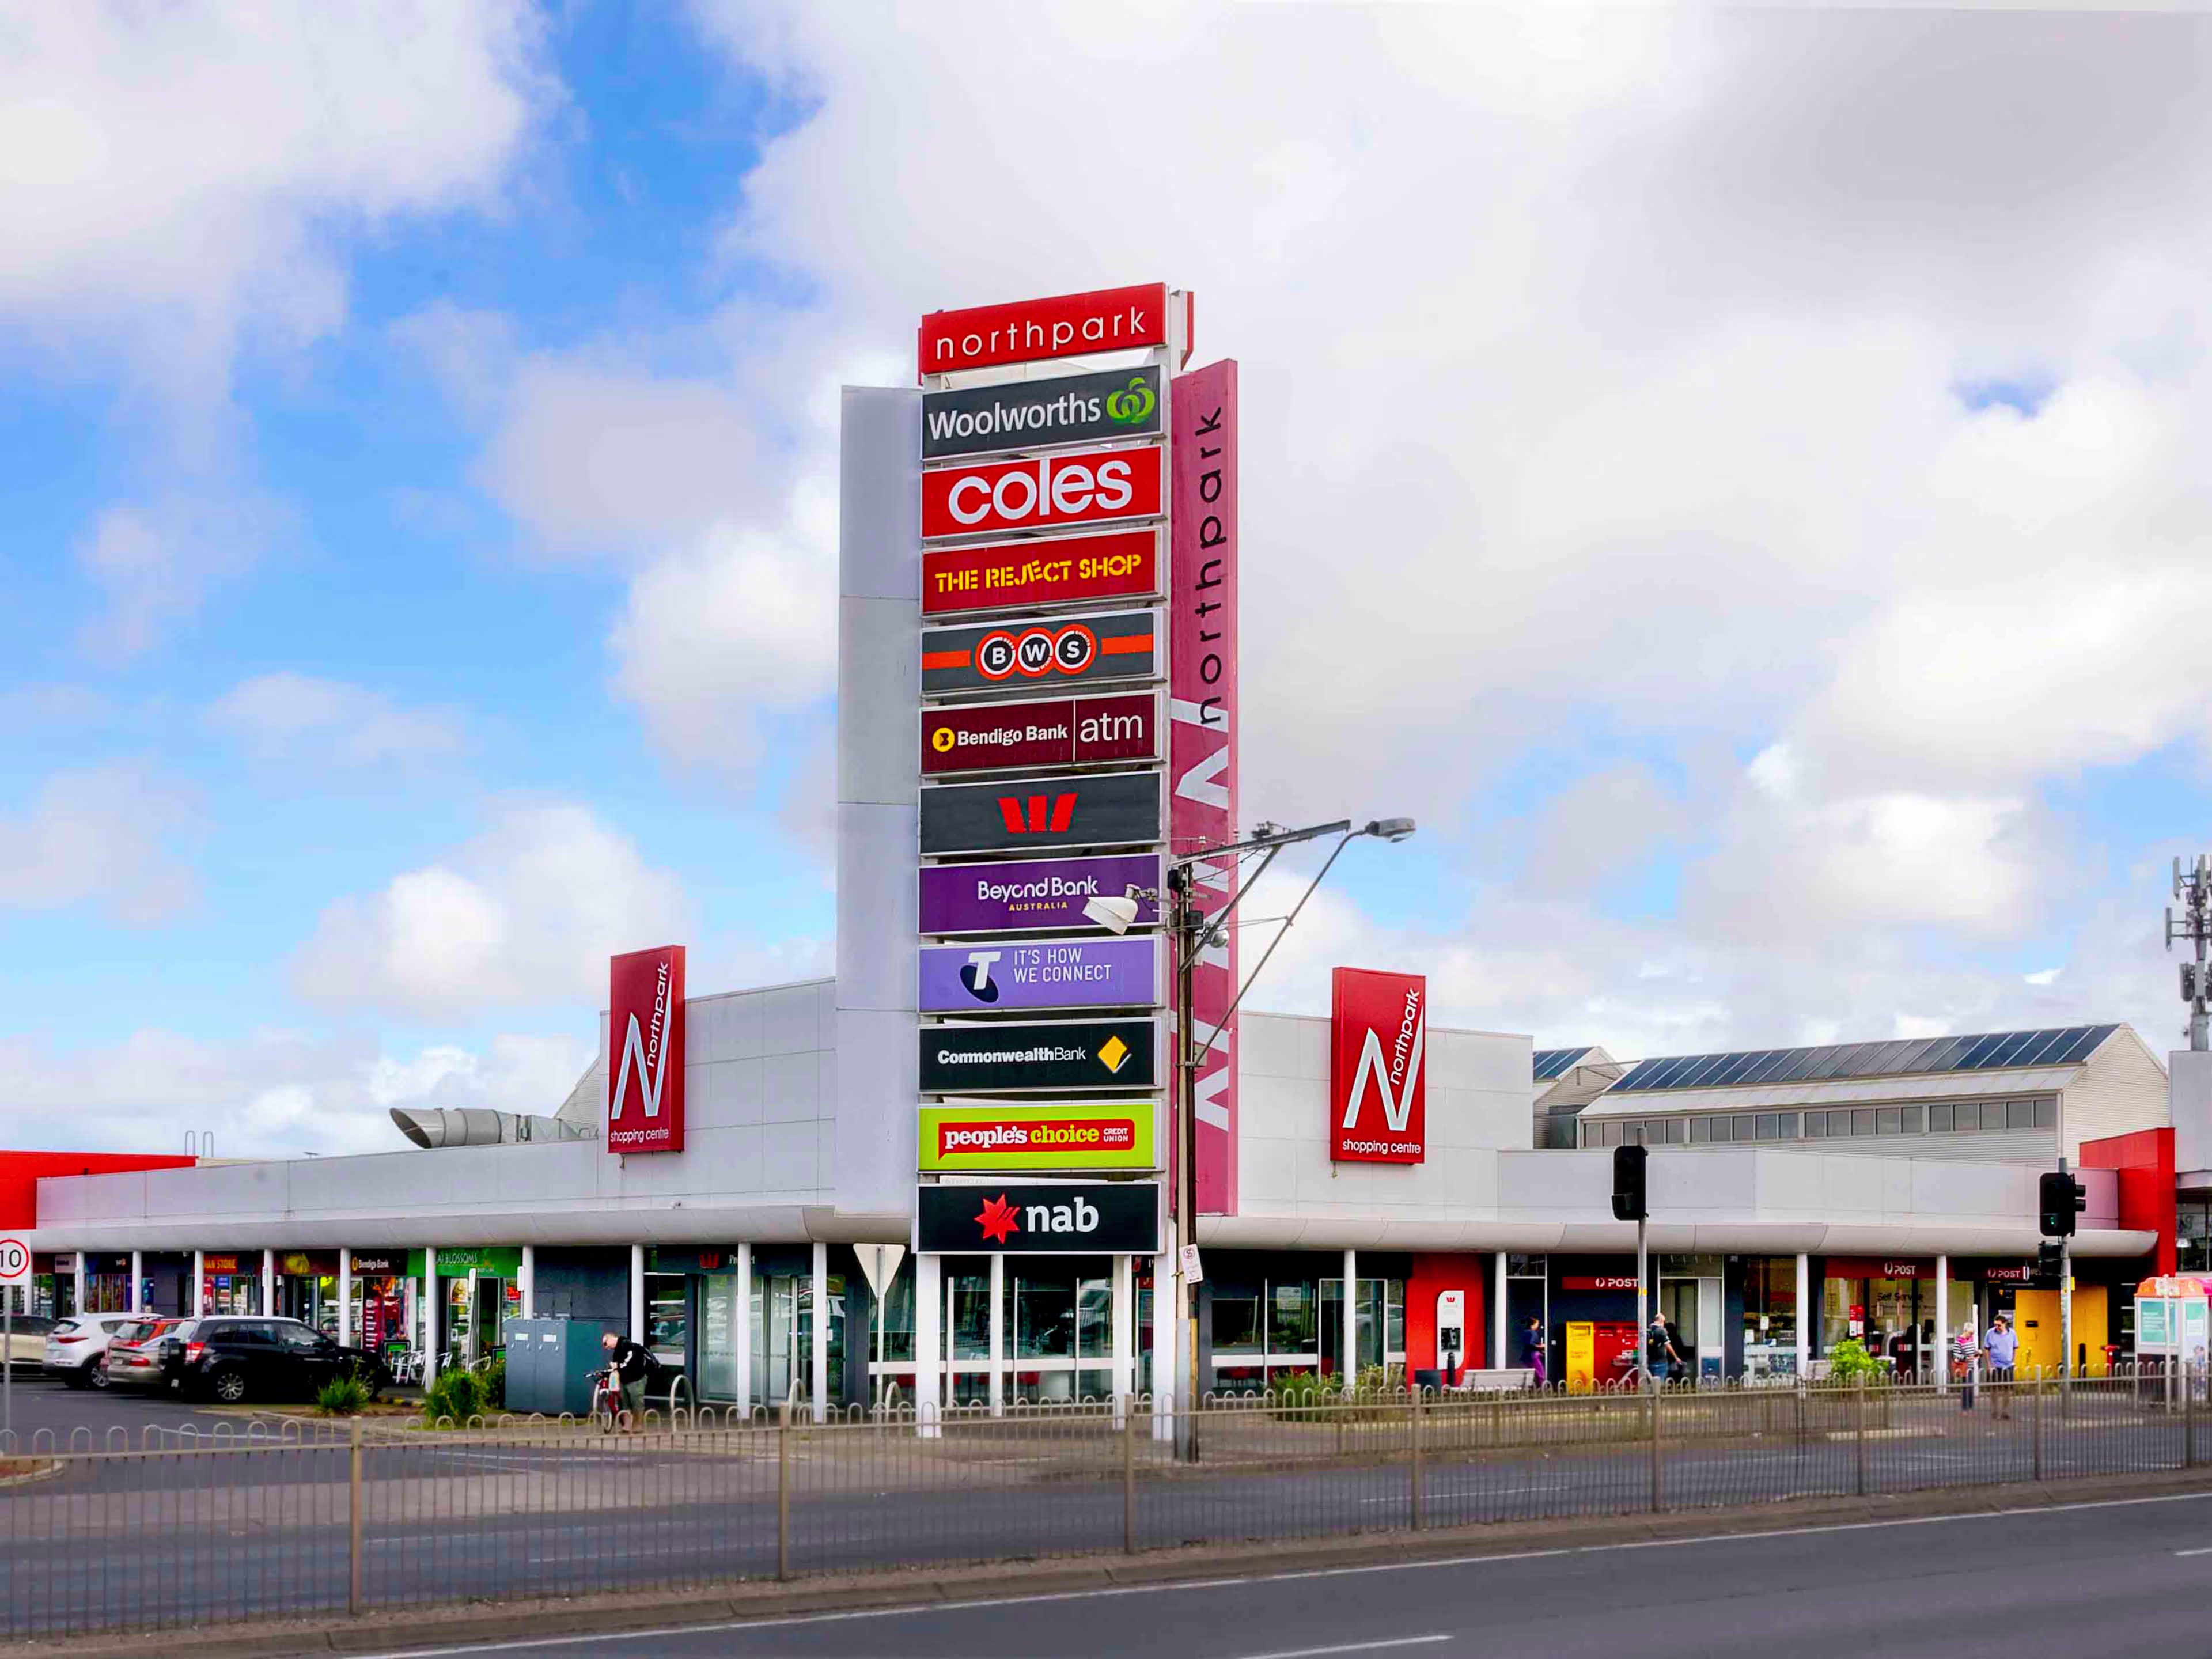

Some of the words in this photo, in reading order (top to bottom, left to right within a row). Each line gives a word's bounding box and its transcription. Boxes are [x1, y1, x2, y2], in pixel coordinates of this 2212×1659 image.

[937, 306, 1145, 360] northpark
[928, 393, 1101, 440] Woolworths
[949, 458, 1132, 525] coles
[935, 570, 978, 593] THE
[986, 560, 1072, 589] REJECT
[1079, 554, 1142, 579] SHOP
[1195, 407, 1226, 725] northpark
[957, 728, 1023, 747] Bendigo
[1026, 724, 1069, 741] Bank
[1080, 713, 1143, 743] atm
[978, 877, 1048, 903] Beyond
[1051, 875, 1099, 896] Bank
[1009, 901, 1069, 912] AUSTRALIA
[1014, 949, 1040, 965] IT'S
[1047, 948, 1082, 964] HOW
[1014, 968, 1037, 983] WE
[1043, 964, 1112, 982] CONNECT
[647, 962, 668, 1068] northpark
[1390, 987, 1420, 1085] northpark
[938, 1046, 1086, 1065] CommonwealthBank
[611, 1129, 645, 1145] shopping
[646, 1128, 669, 1141] centre
[945, 1125, 1028, 1149] people's
[1030, 1124, 1100, 1143] choice
[1103, 1127, 1128, 1135] CREDIT
[1103, 1134, 1128, 1142] UNION
[1343, 1139, 1388, 1155] shopping
[1391, 1142, 1421, 1154] centre
[1026, 1196, 1099, 1233] nab
[0, 1249, 21, 1268] 10
[377, 1259, 389, 1269] Bank
[1894, 1265, 1916, 1275] POST
[1998, 1270, 2021, 1278] POST
[1608, 1278, 1638, 1287] POST
